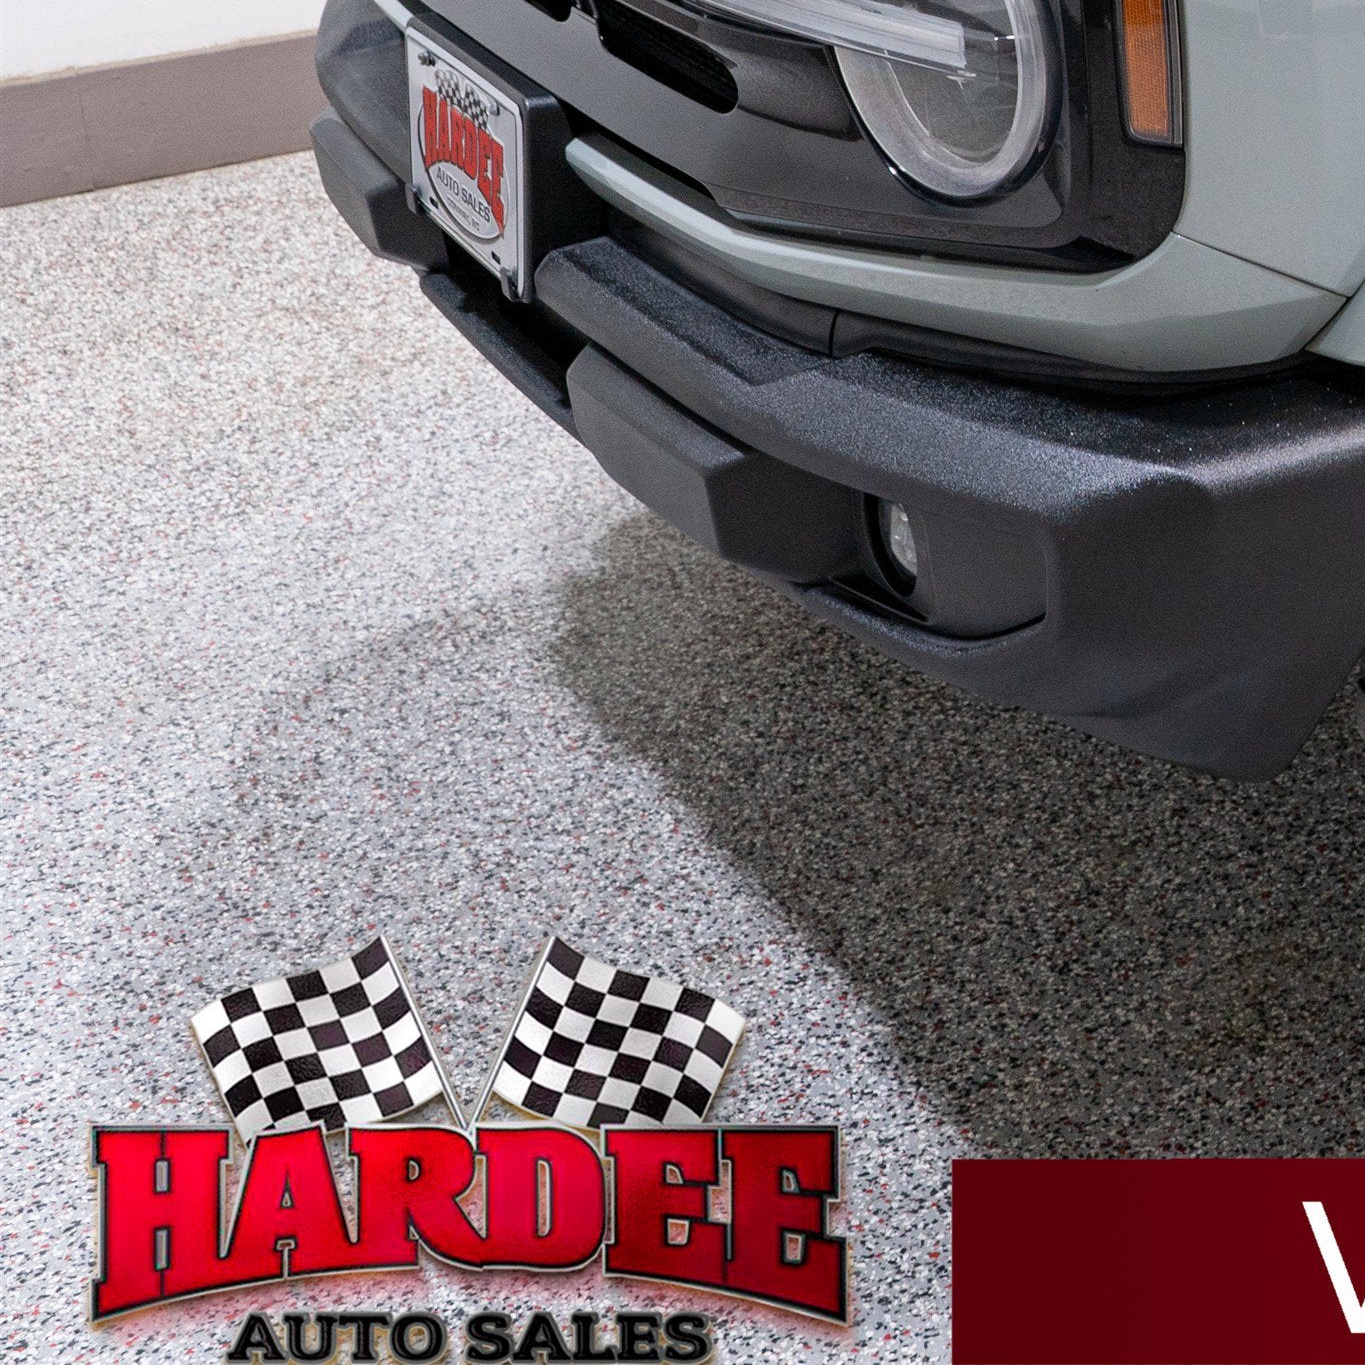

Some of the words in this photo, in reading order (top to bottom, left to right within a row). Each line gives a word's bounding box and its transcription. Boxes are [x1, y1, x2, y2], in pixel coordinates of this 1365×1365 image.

[422, 84, 505, 236] HARDEE
[436, 167, 459, 196] AUTO
[461, 188, 490, 223] SALES
